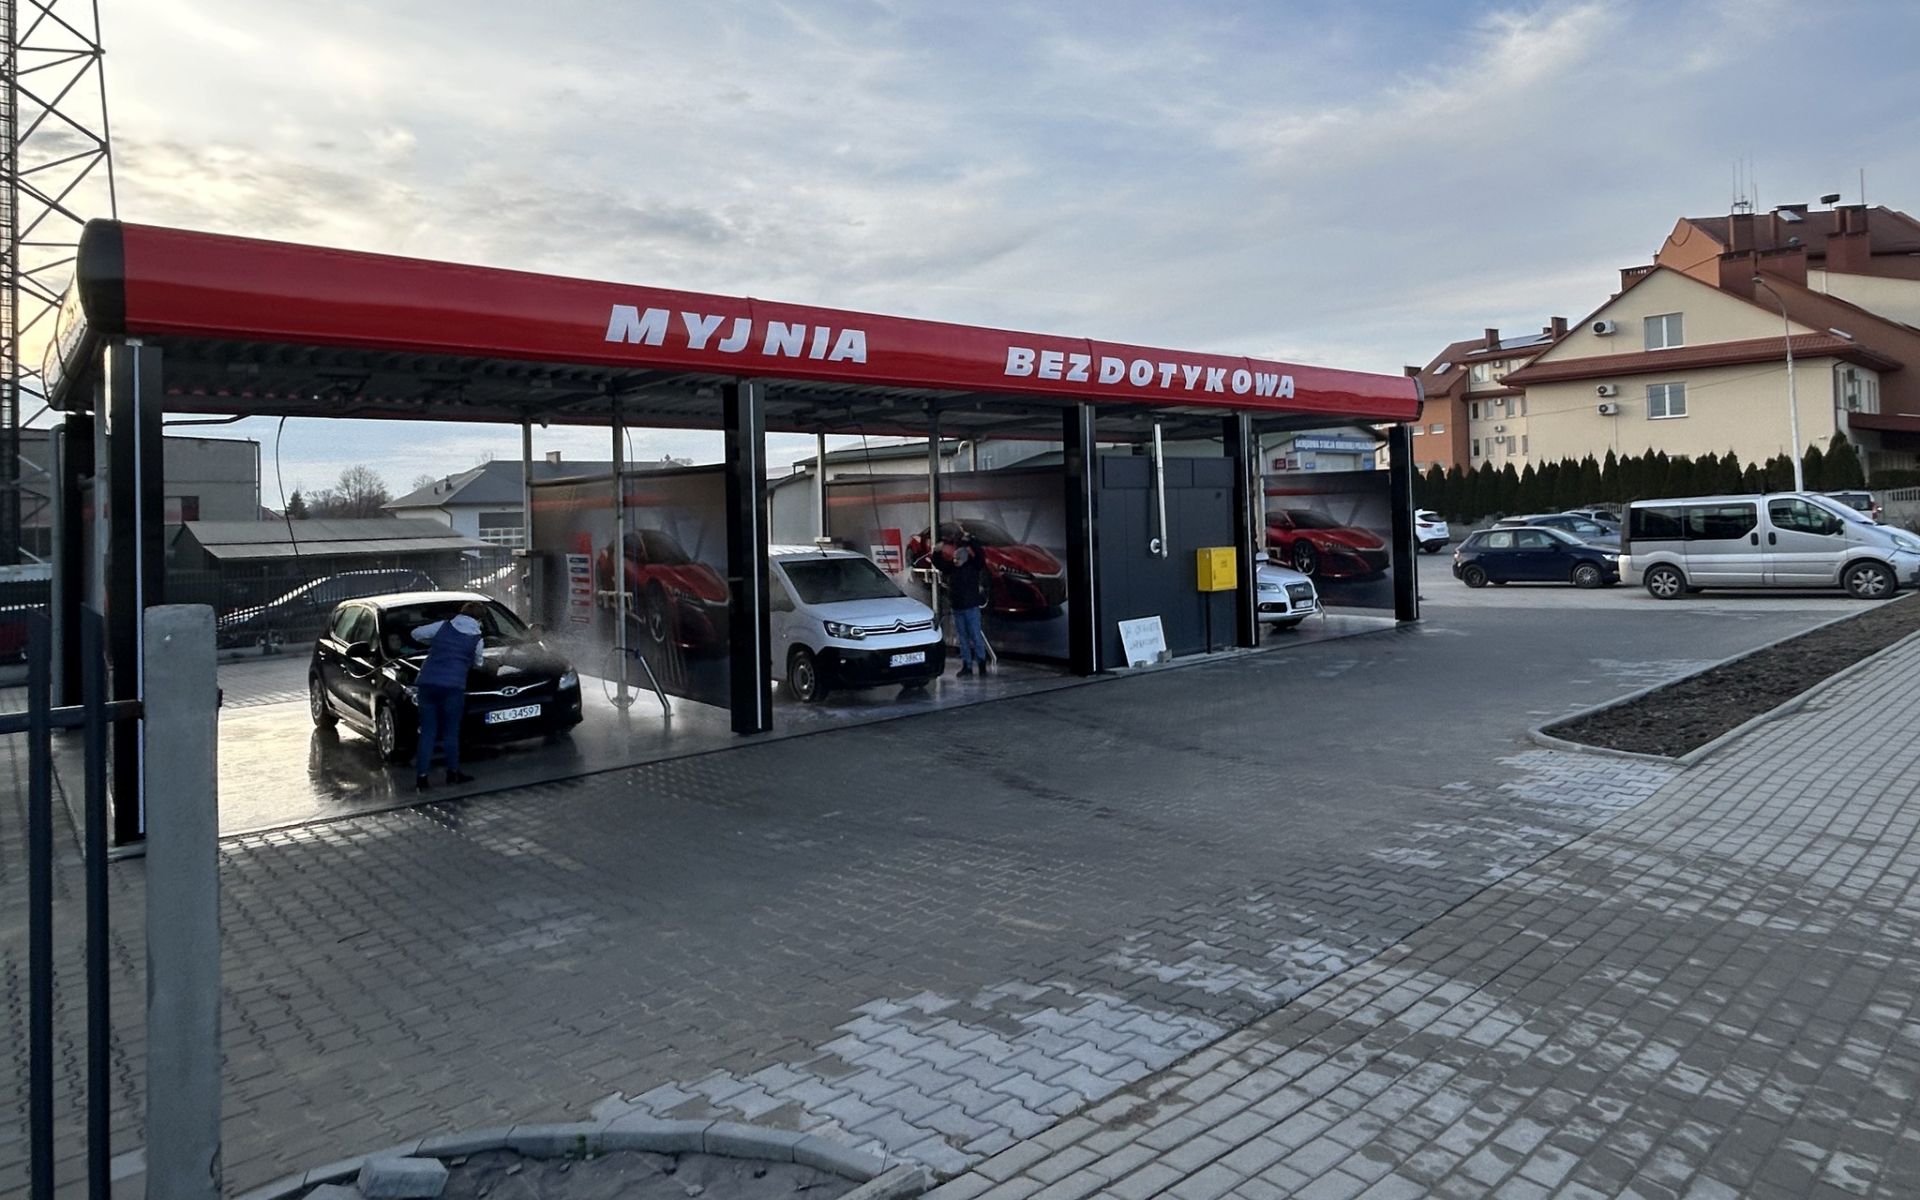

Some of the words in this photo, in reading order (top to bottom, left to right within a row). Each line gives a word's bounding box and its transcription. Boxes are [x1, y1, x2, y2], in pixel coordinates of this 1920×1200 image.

[605, 304, 867, 363] MYJNIA
[490, 712, 509, 722] RKL
[512, 705, 539, 719] 34597
